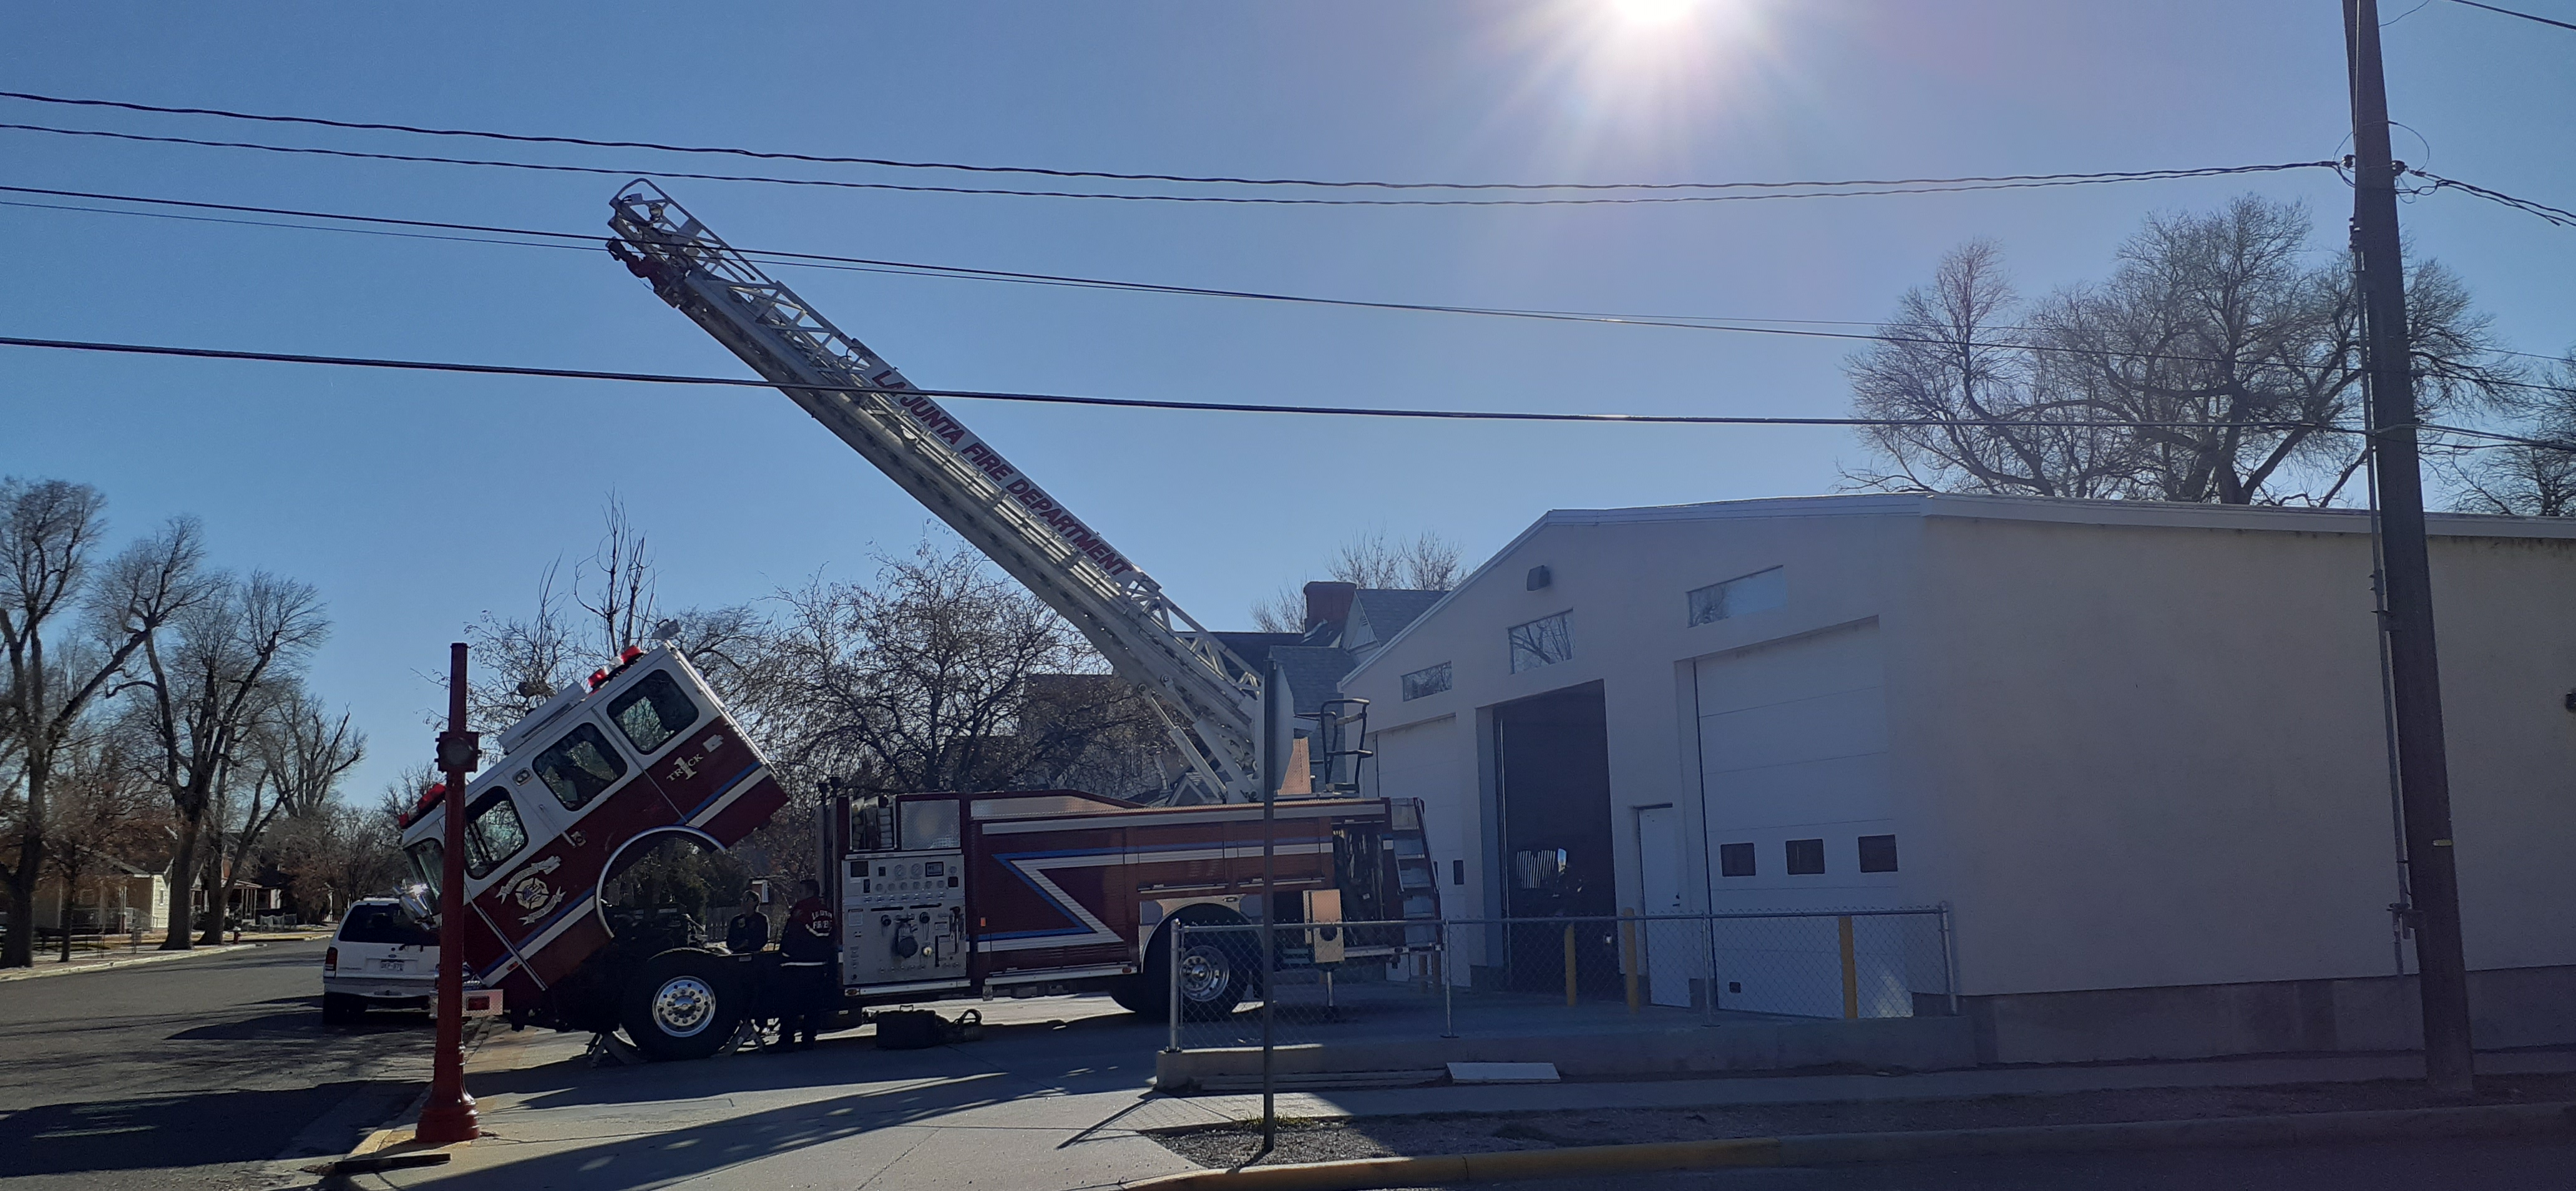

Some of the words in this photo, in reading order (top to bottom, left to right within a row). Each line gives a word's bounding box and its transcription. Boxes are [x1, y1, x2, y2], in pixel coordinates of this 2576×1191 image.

[872, 370, 907, 398] LA
[900, 396, 965, 445] JUNTA
[961, 442, 1014, 481] FIRE
[1006, 478, 1133, 576] DEPARTMENT
[674, 757, 697, 780] 1
